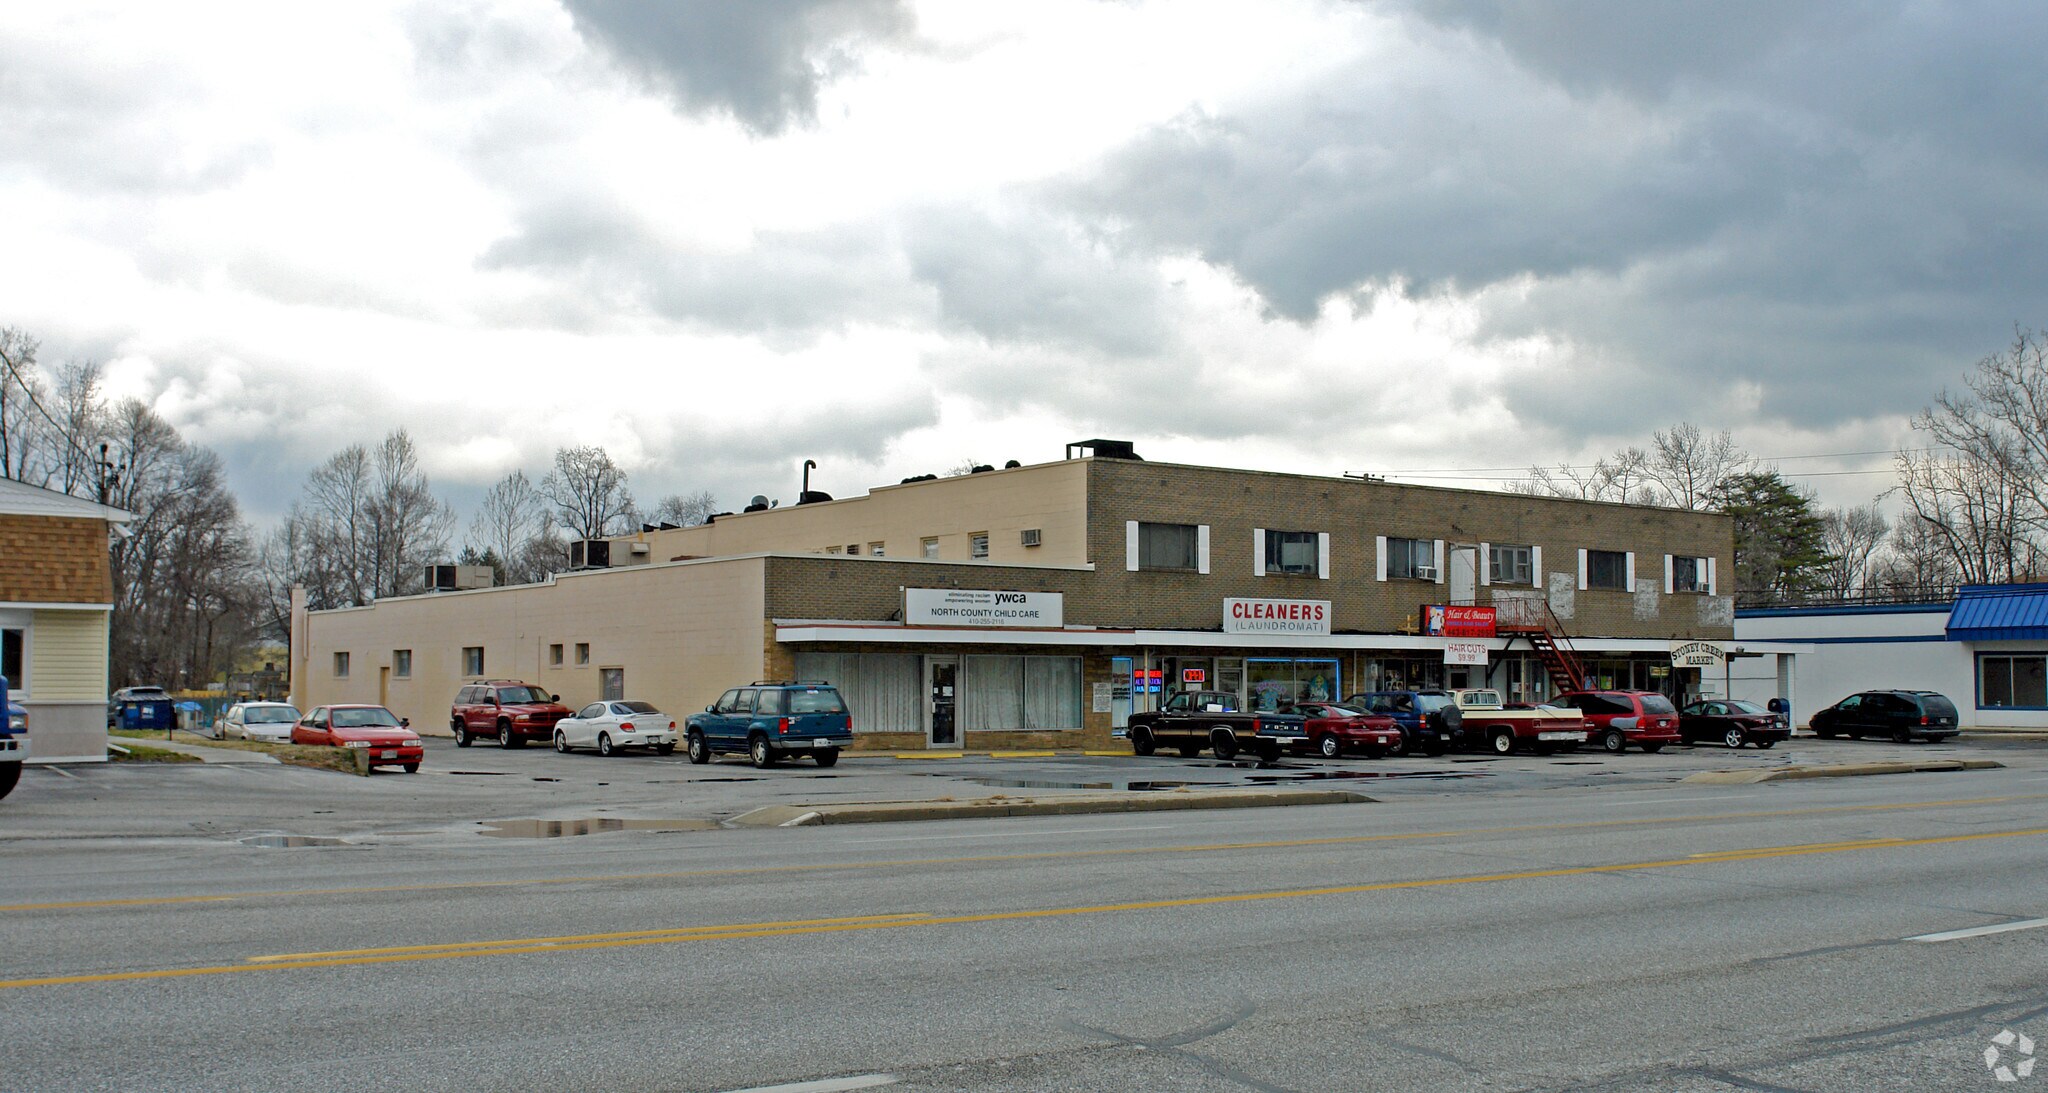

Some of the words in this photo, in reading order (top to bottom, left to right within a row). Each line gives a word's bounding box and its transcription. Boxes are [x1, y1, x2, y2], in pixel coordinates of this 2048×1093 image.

[994, 593, 1027, 605] ywca
[931, 608, 959, 616] NORTH
[960, 609, 992, 617] COUNTY
[994, 610, 1017, 618] CHILD
[1018, 610, 1040, 618] CARE
[1232, 602, 1324, 621] CLEANERS
[1447, 609, 1463, 619] Hair
[1463, 609, 1471, 619] &
[1471, 610, 1494, 623] Beauty
[1235, 621, 1324, 632] (LAUNDROMAT)
[1448, 643, 1466, 653] HAIR
[1466, 644, 1486, 654] CUTS
[1671, 642, 1700, 661] STONEY
[1457, 653, 1476, 662] $9.99
[1685, 656, 1714, 665] MARKET
